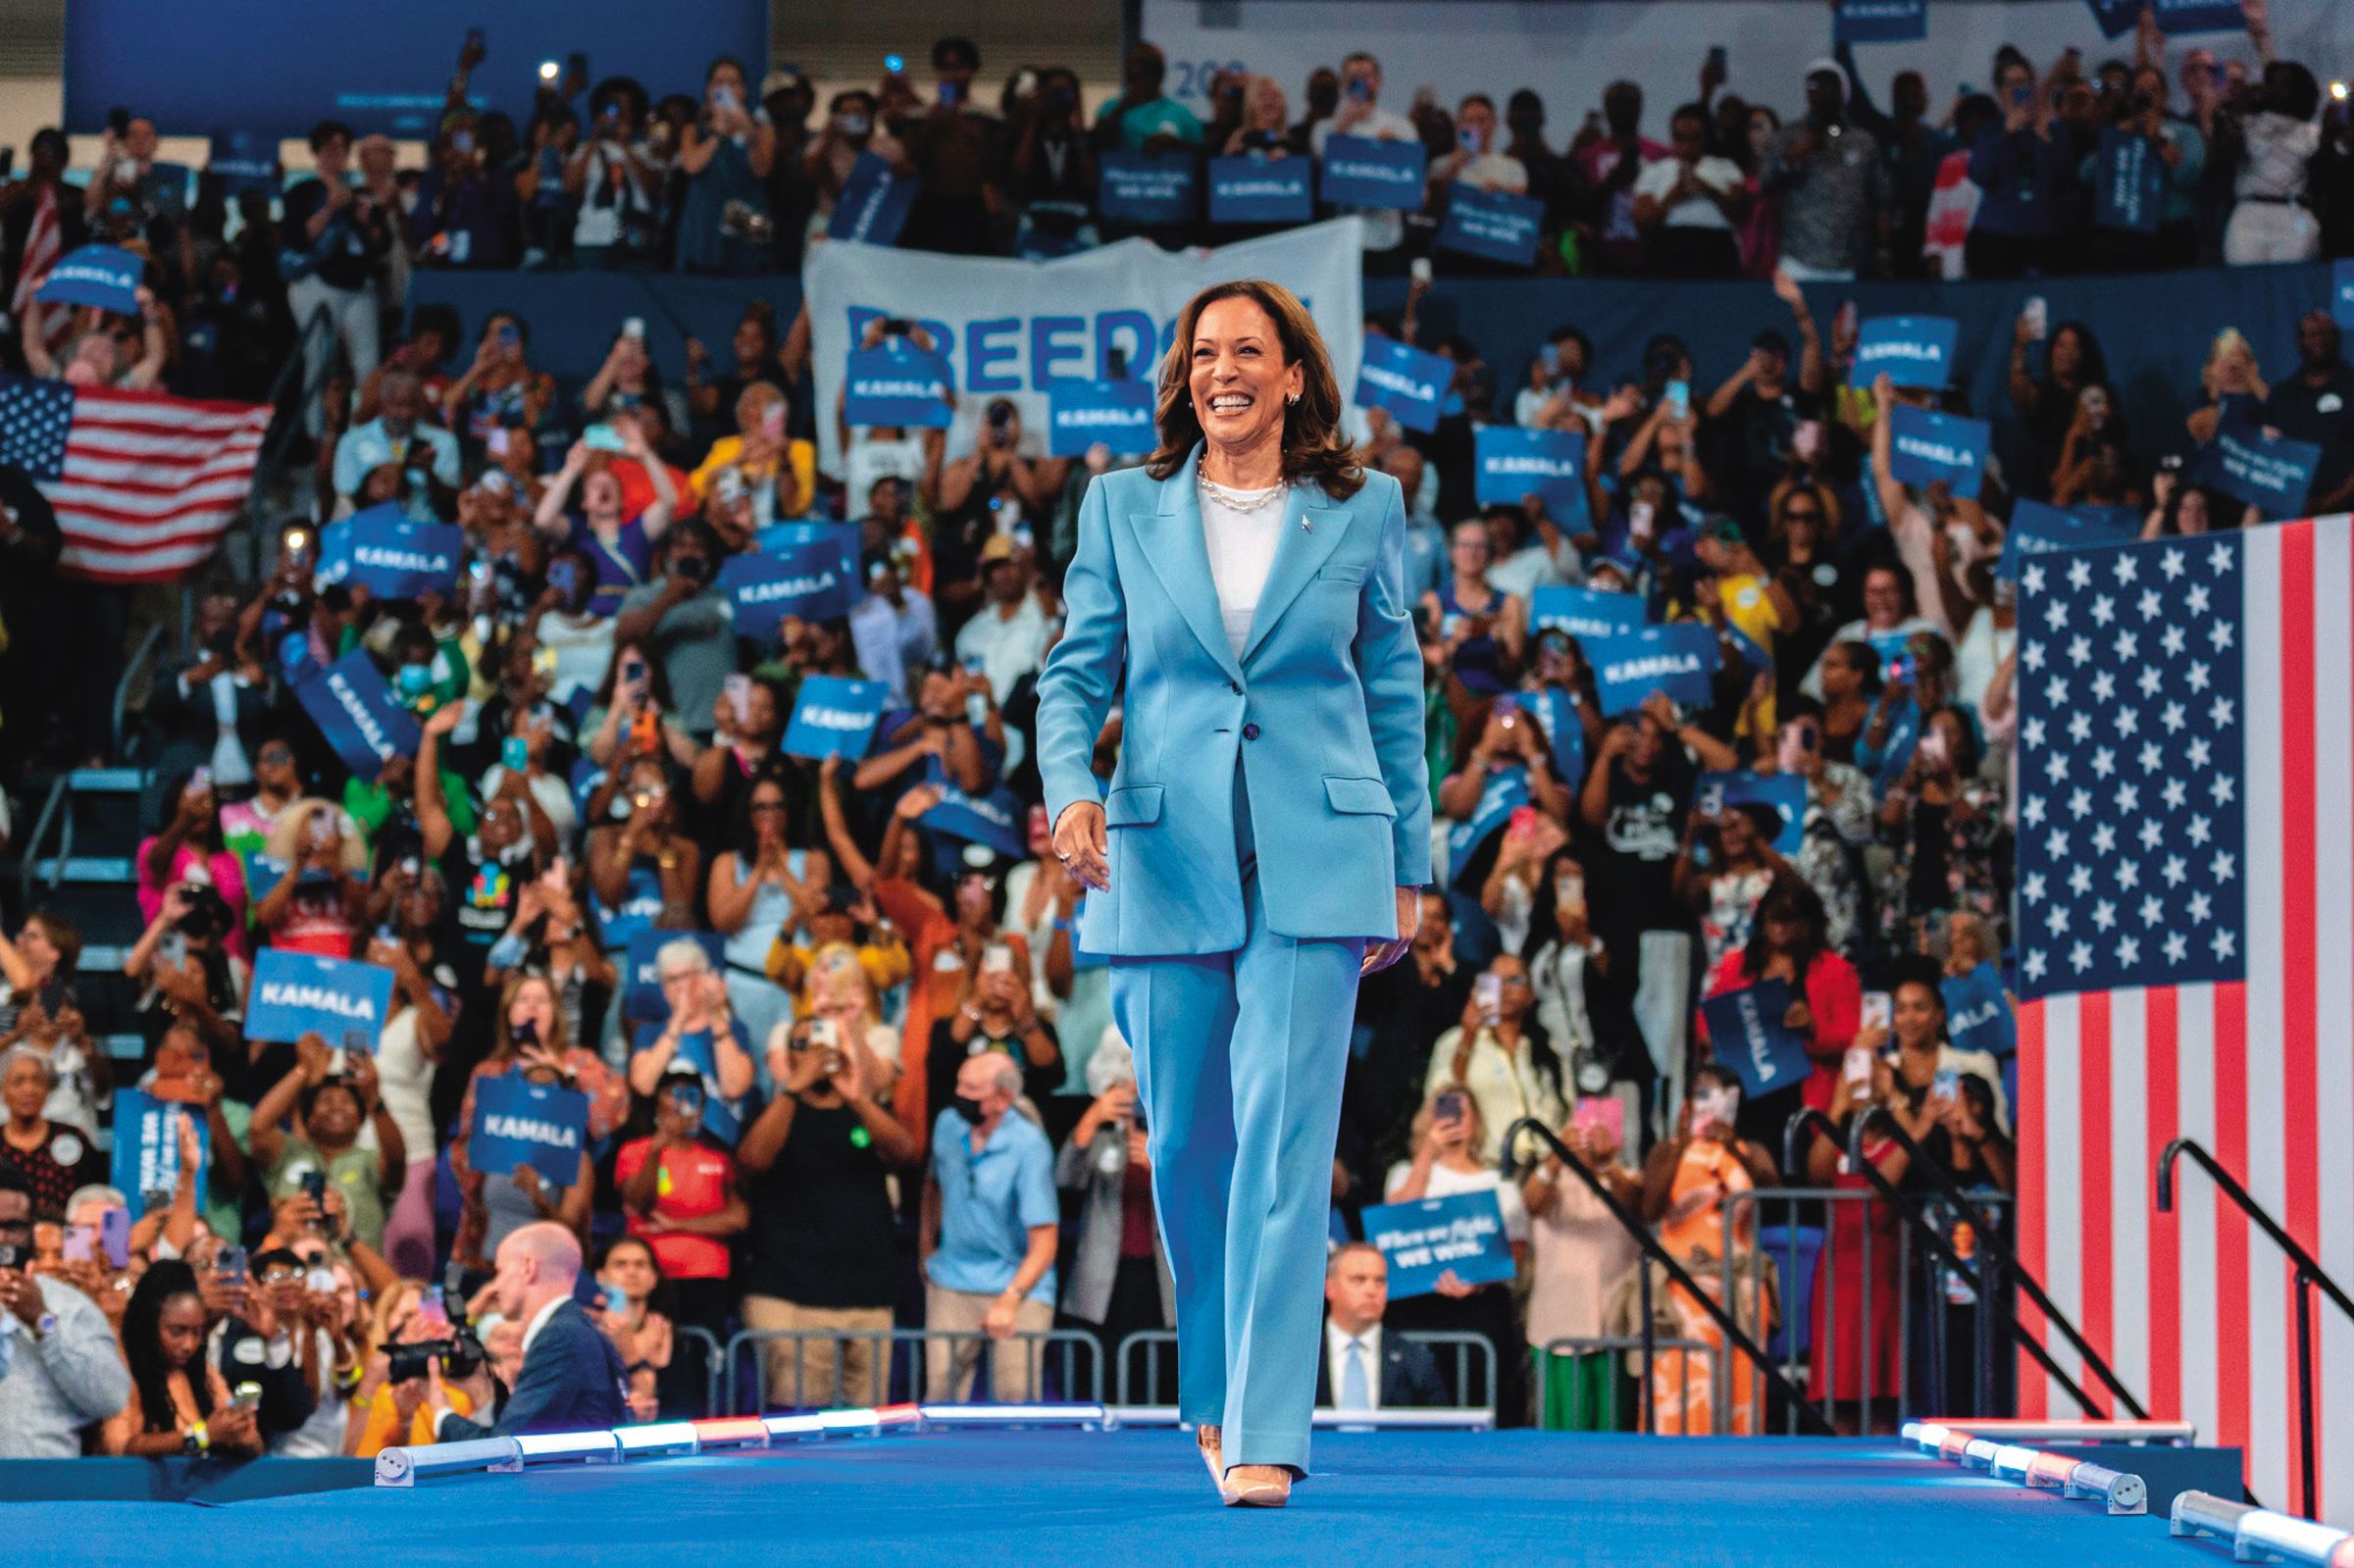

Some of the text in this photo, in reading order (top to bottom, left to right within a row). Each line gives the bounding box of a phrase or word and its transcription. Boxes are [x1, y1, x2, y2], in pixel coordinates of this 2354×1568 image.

[354, 546, 449, 573] KAMALA
[738, 572, 834, 603] KAMALA
[1604, 653, 1701, 684] KAMALA
[262, 983, 375, 1021] KAMALA
[485, 1114, 577, 1148] KAMALA
[1394, 1248, 1432, 1268] WE
